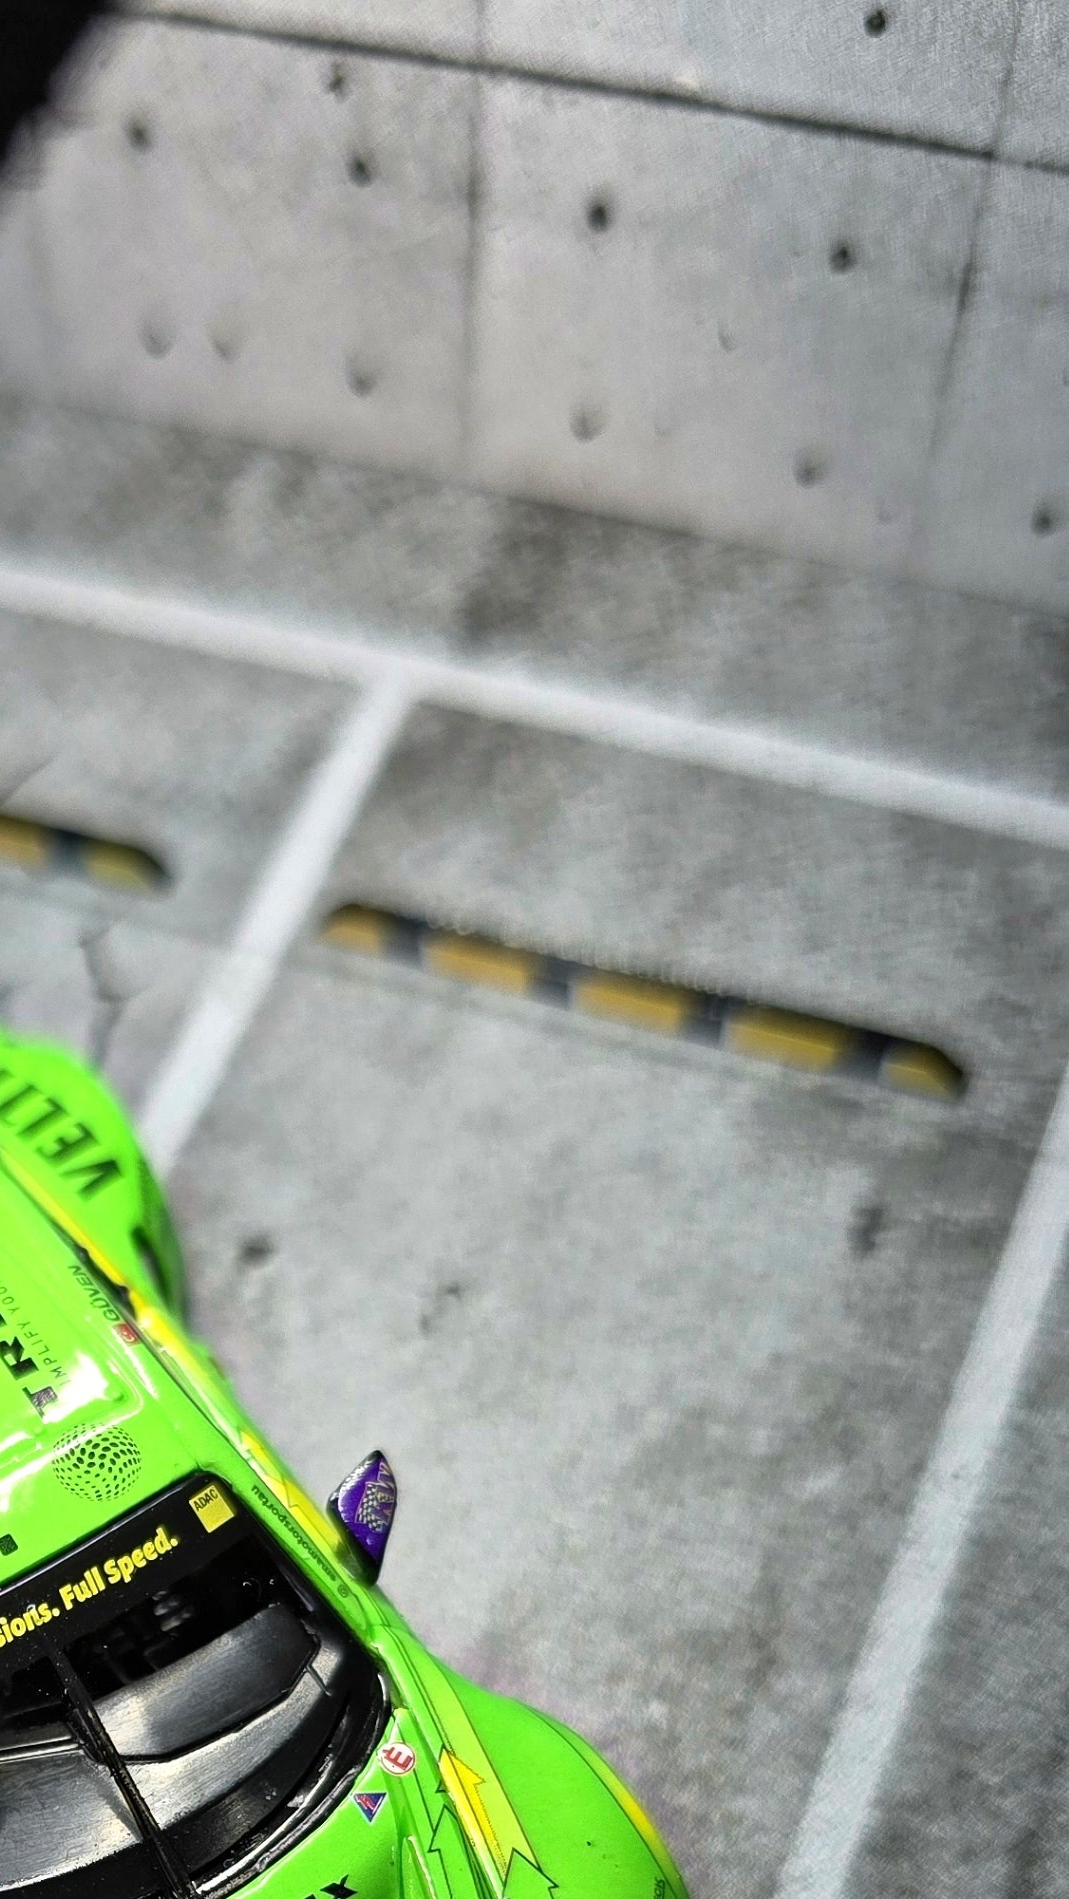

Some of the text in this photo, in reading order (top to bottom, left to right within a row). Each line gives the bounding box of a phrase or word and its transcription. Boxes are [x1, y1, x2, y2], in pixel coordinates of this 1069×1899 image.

[17, 1319, 72, 1386] IMPLIFY
[193, 1487, 219, 1512] ADAC
[59, 1563, 105, 1610] Full
[104, 1526, 179, 1584] Speed.
